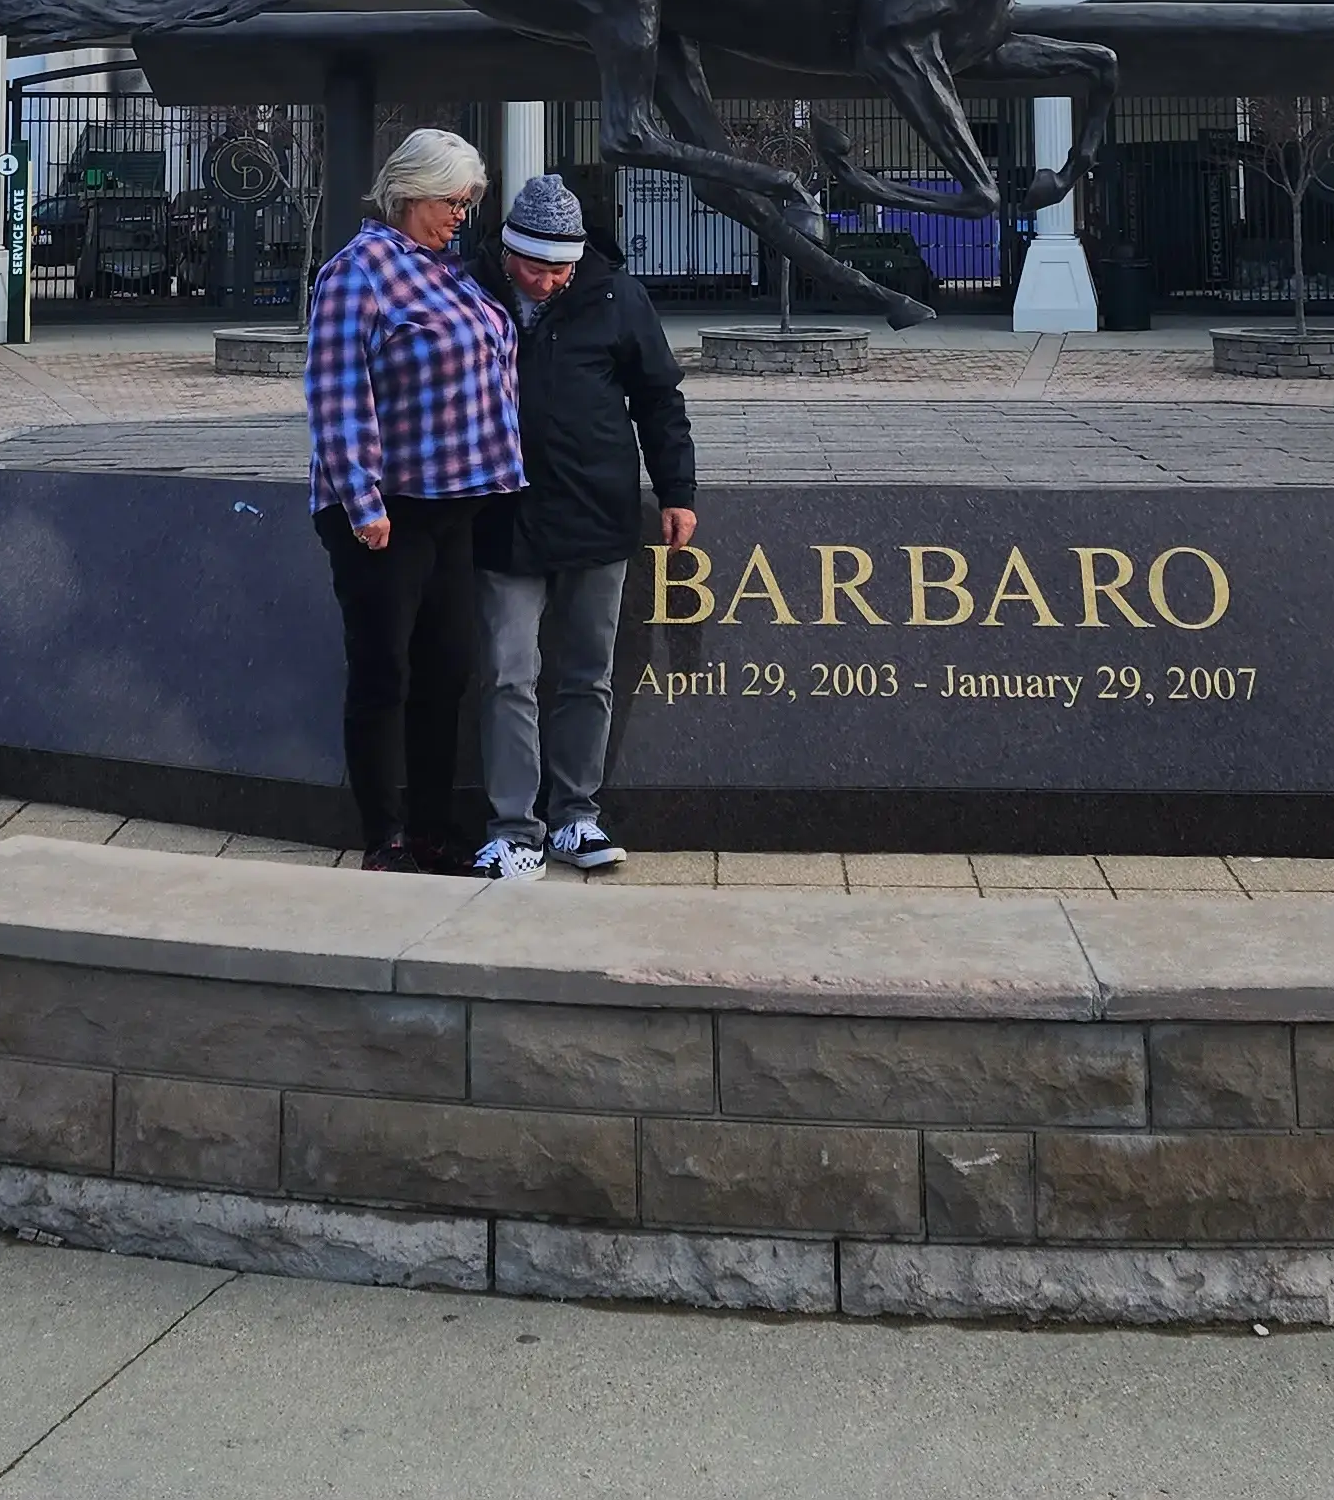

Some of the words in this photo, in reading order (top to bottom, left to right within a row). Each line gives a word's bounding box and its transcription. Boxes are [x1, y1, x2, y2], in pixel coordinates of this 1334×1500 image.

[2, 158, 12, 171] 1
[13, 188, 25, 222] GATE
[12, 223, 24, 275] SERVICE
[643, 543, 1231, 631] BARBARO
[632, 661, 727, 704] April
[740, 662, 797, 702] 29,
[810, 662, 899, 698] 2003
[941, 664, 1083, 708] January
[1096, 665, 1154, 707] 29,
[1168, 666, 1258, 702] 2007
